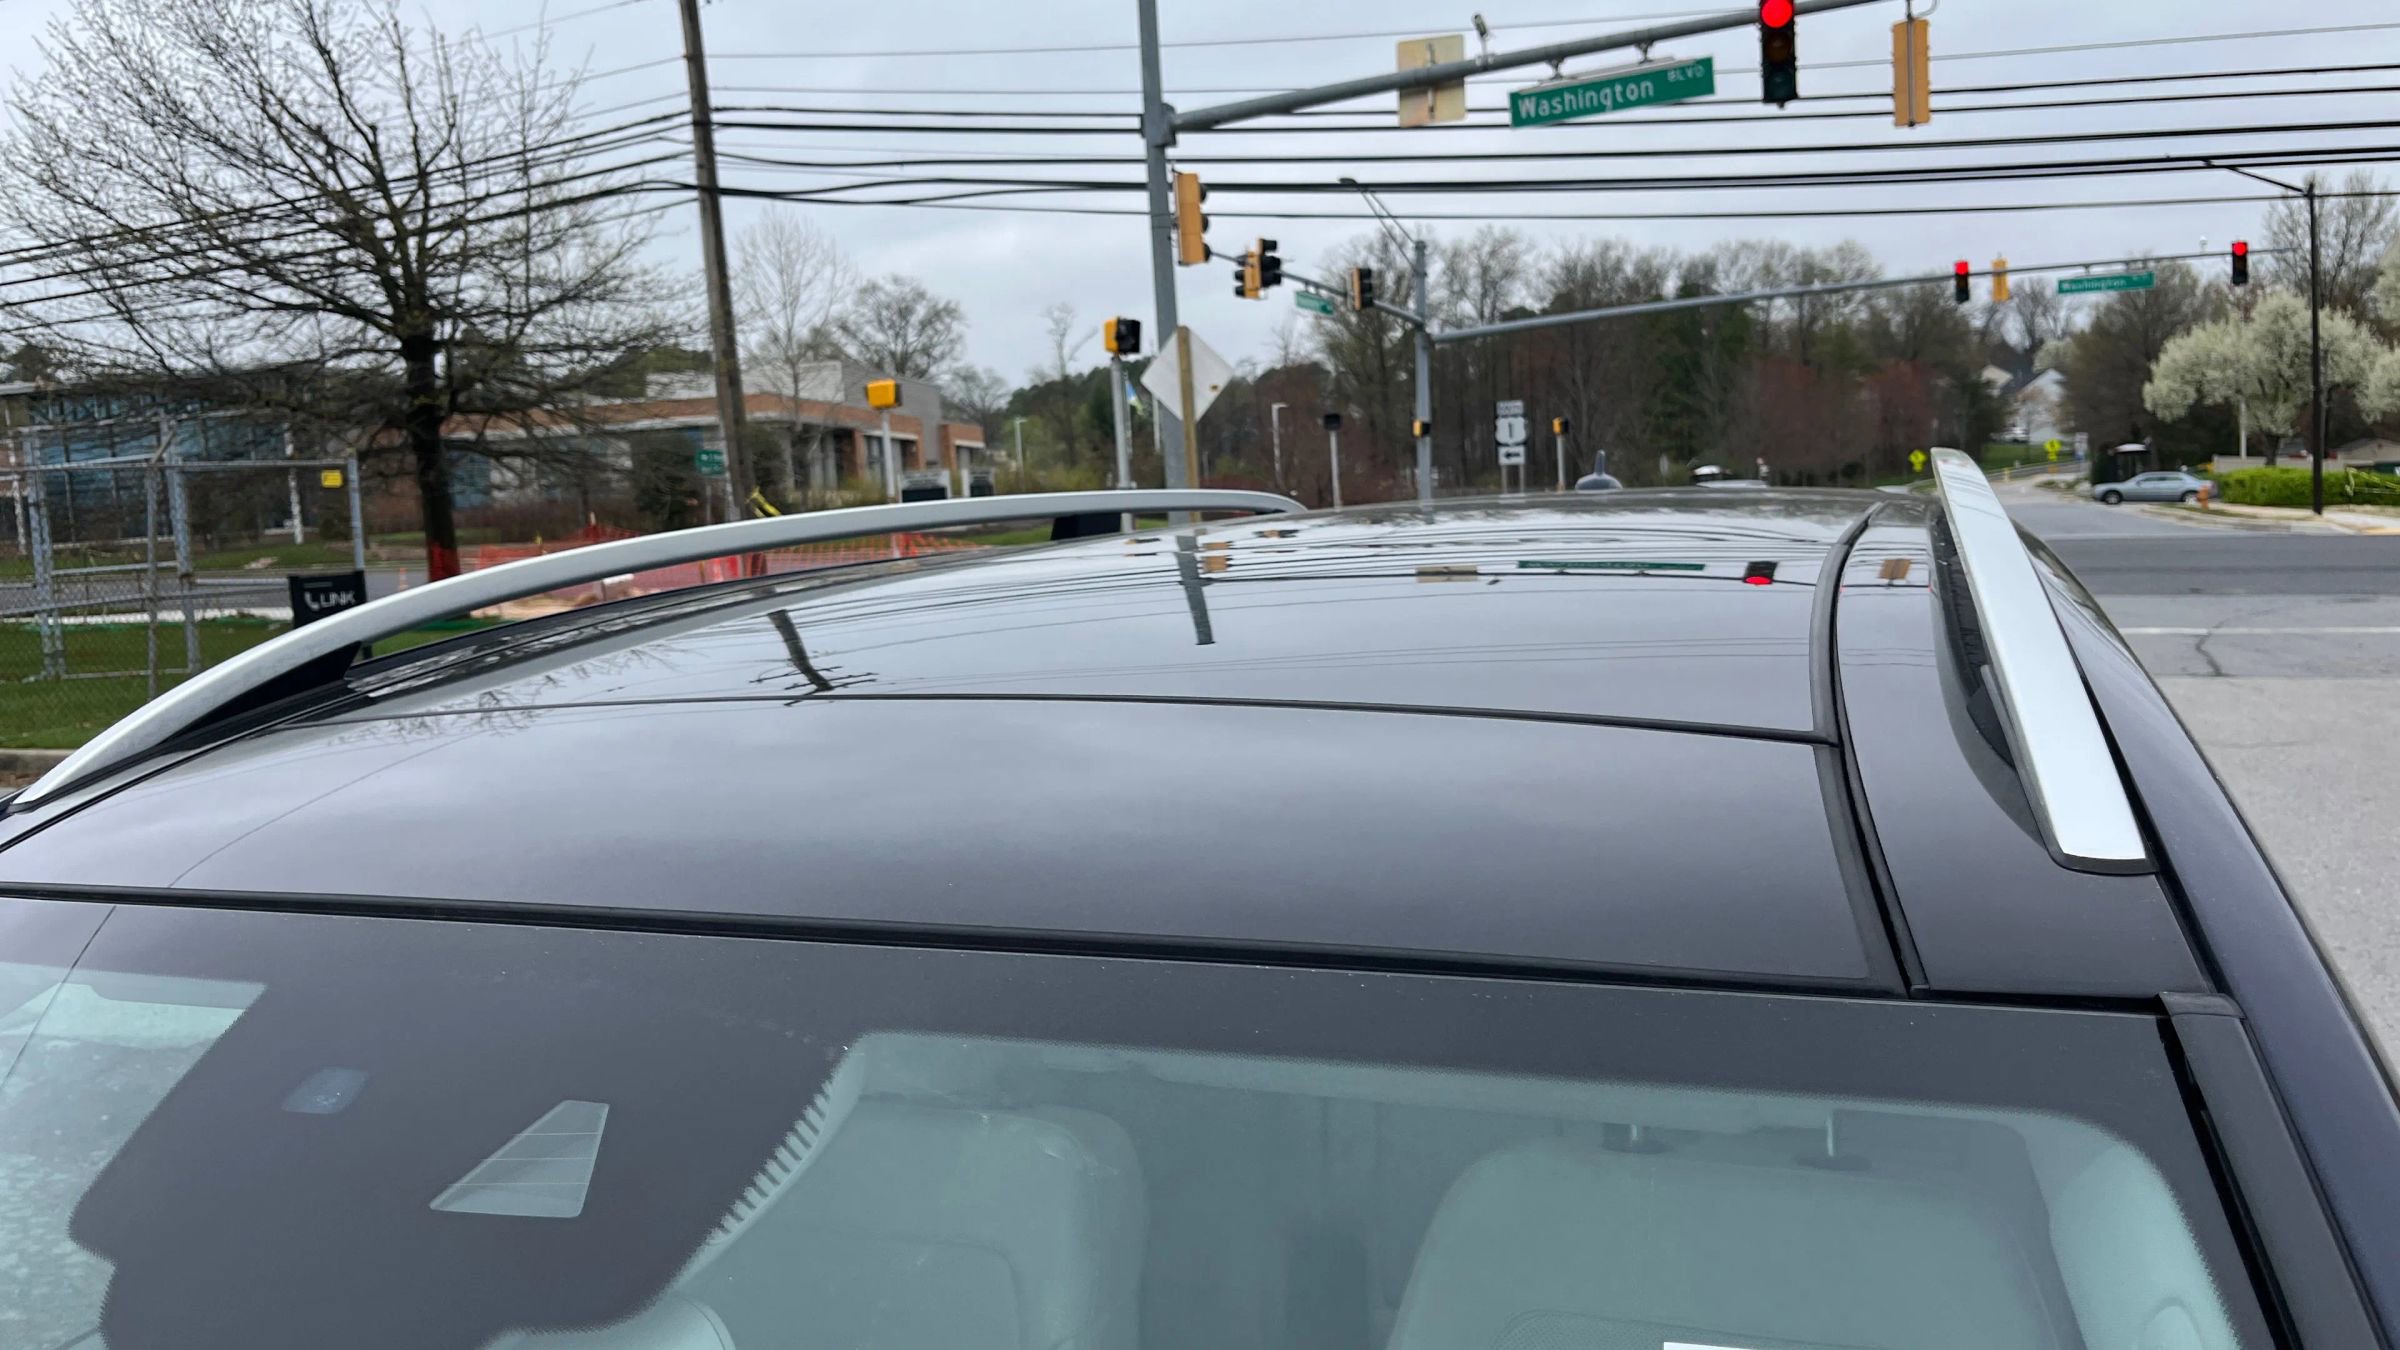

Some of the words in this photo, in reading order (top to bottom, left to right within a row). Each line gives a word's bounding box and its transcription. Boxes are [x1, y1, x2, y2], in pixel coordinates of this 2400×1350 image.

[1518, 81, 1654, 119] Washington
[1667, 65, 1705, 82] BLVD
[1507, 421, 1514, 440] 1
